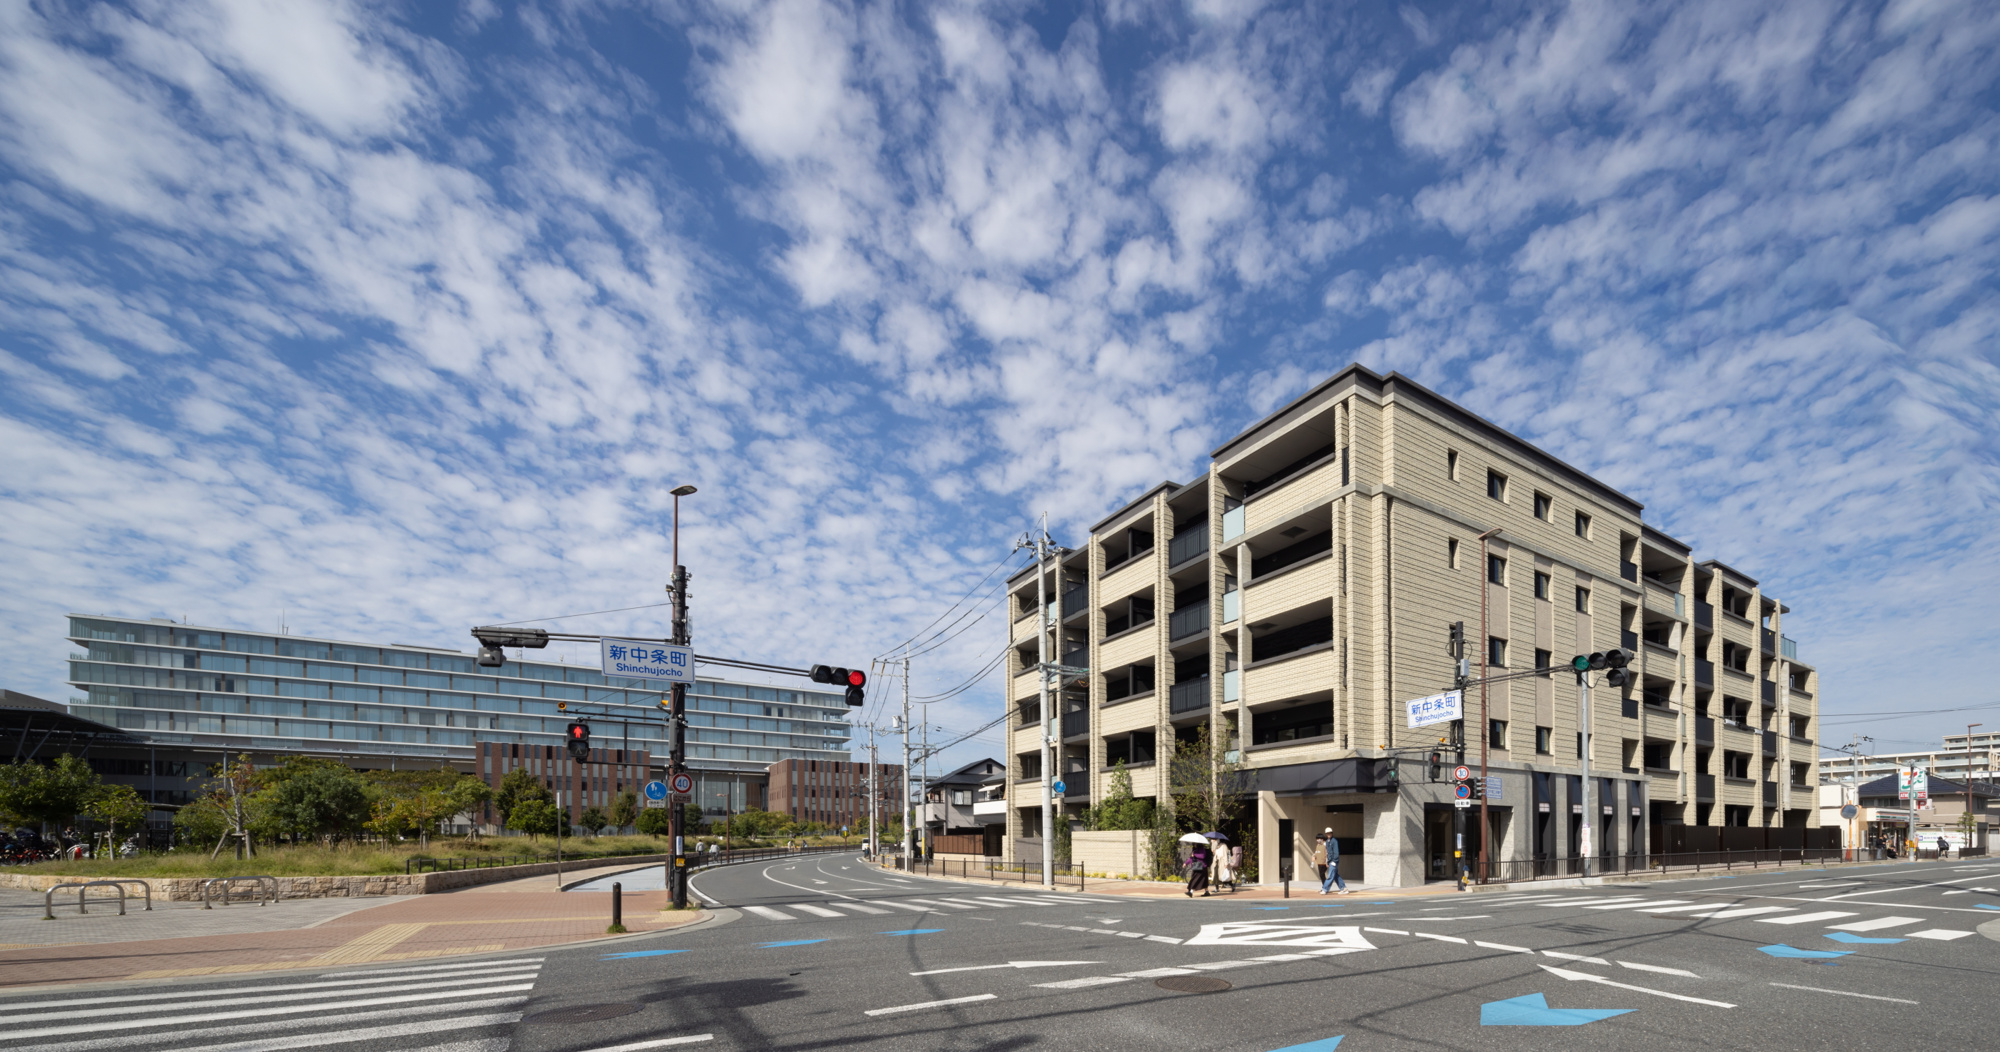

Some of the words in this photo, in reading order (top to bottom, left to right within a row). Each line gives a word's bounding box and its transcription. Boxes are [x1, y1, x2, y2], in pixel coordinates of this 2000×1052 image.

[609, 645, 687, 667] 新中条町
[616, 662, 683, 677] Shinchujocho
[1411, 696, 1456, 715] 新中条町
[1415, 710, 1454, 723] Shinchujocho
[677, 779, 688, 788] 40
[1918, 800, 1927, 810] P
